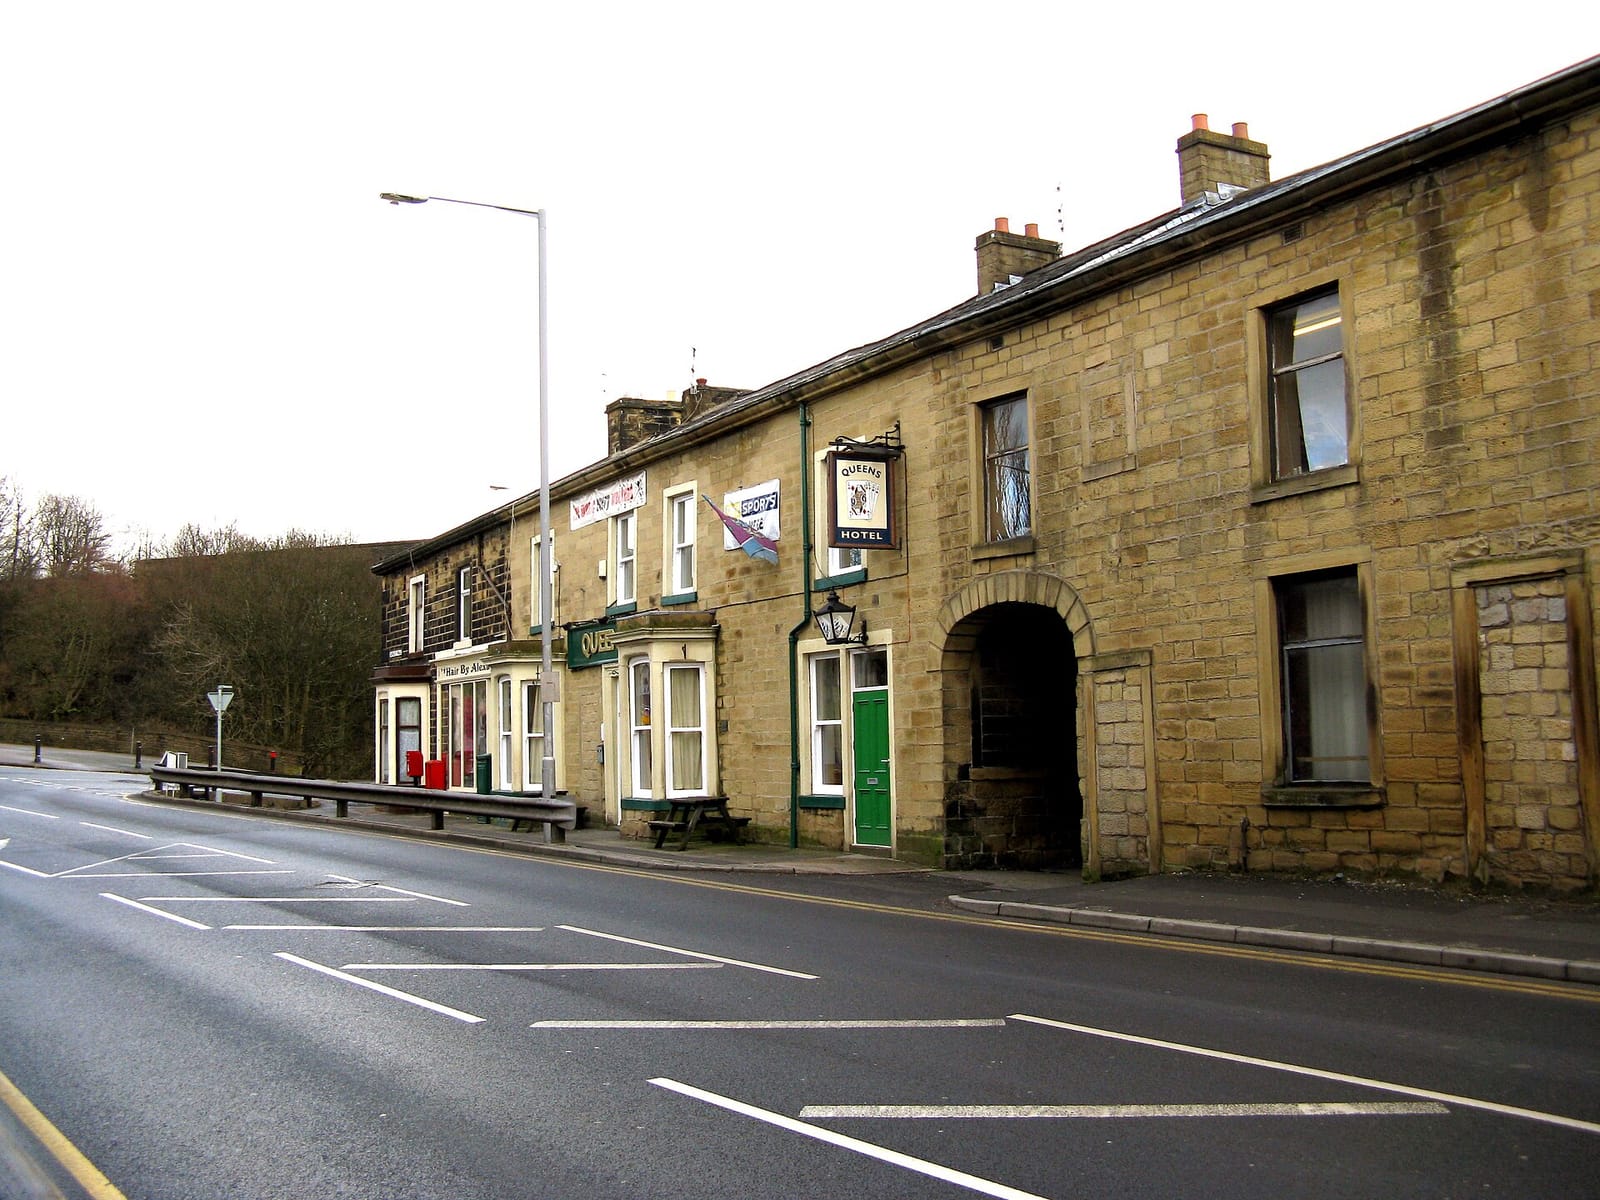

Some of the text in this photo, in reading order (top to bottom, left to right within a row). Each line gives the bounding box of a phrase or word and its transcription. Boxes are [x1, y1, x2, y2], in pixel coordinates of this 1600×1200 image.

[841, 464, 882, 479] QUEENS
[742, 494, 777, 516] SPORTS
[841, 530, 883, 540] HOTEL
[460, 664, 470, 676] By
